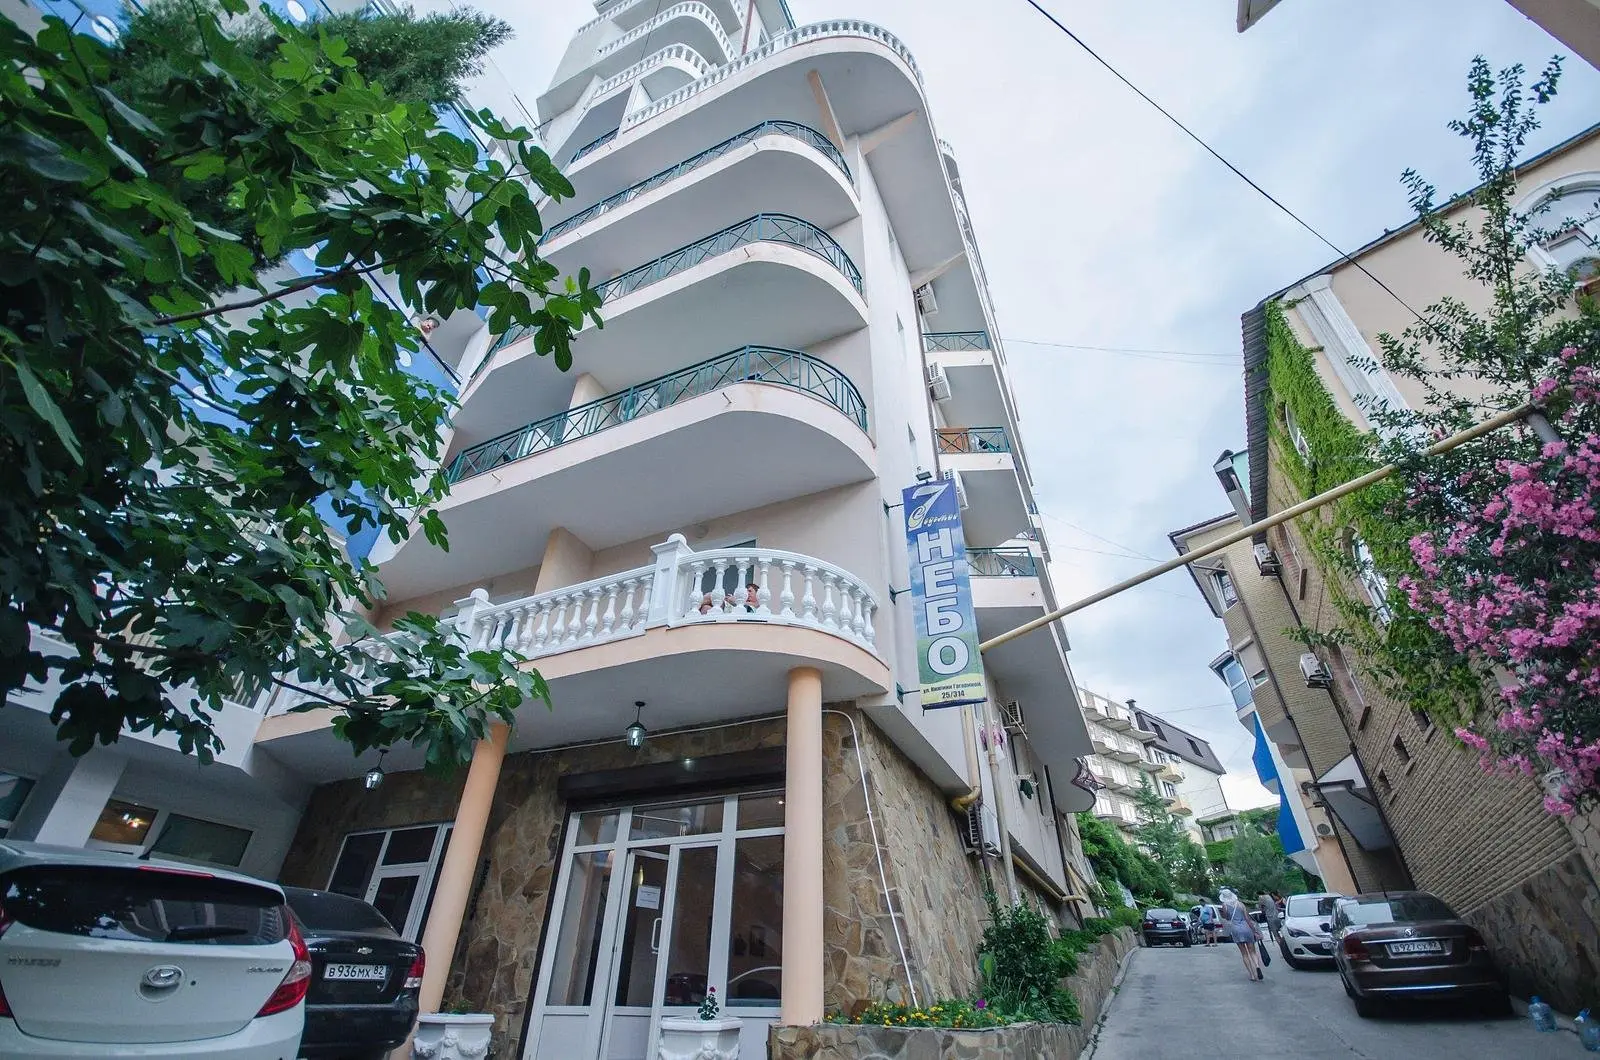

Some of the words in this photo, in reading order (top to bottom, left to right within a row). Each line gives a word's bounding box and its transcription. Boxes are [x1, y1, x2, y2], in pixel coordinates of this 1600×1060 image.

[908, 483, 949, 531] 7
[916, 527, 970, 675] НЕБО
[941, 690, 965, 698] 25/314
